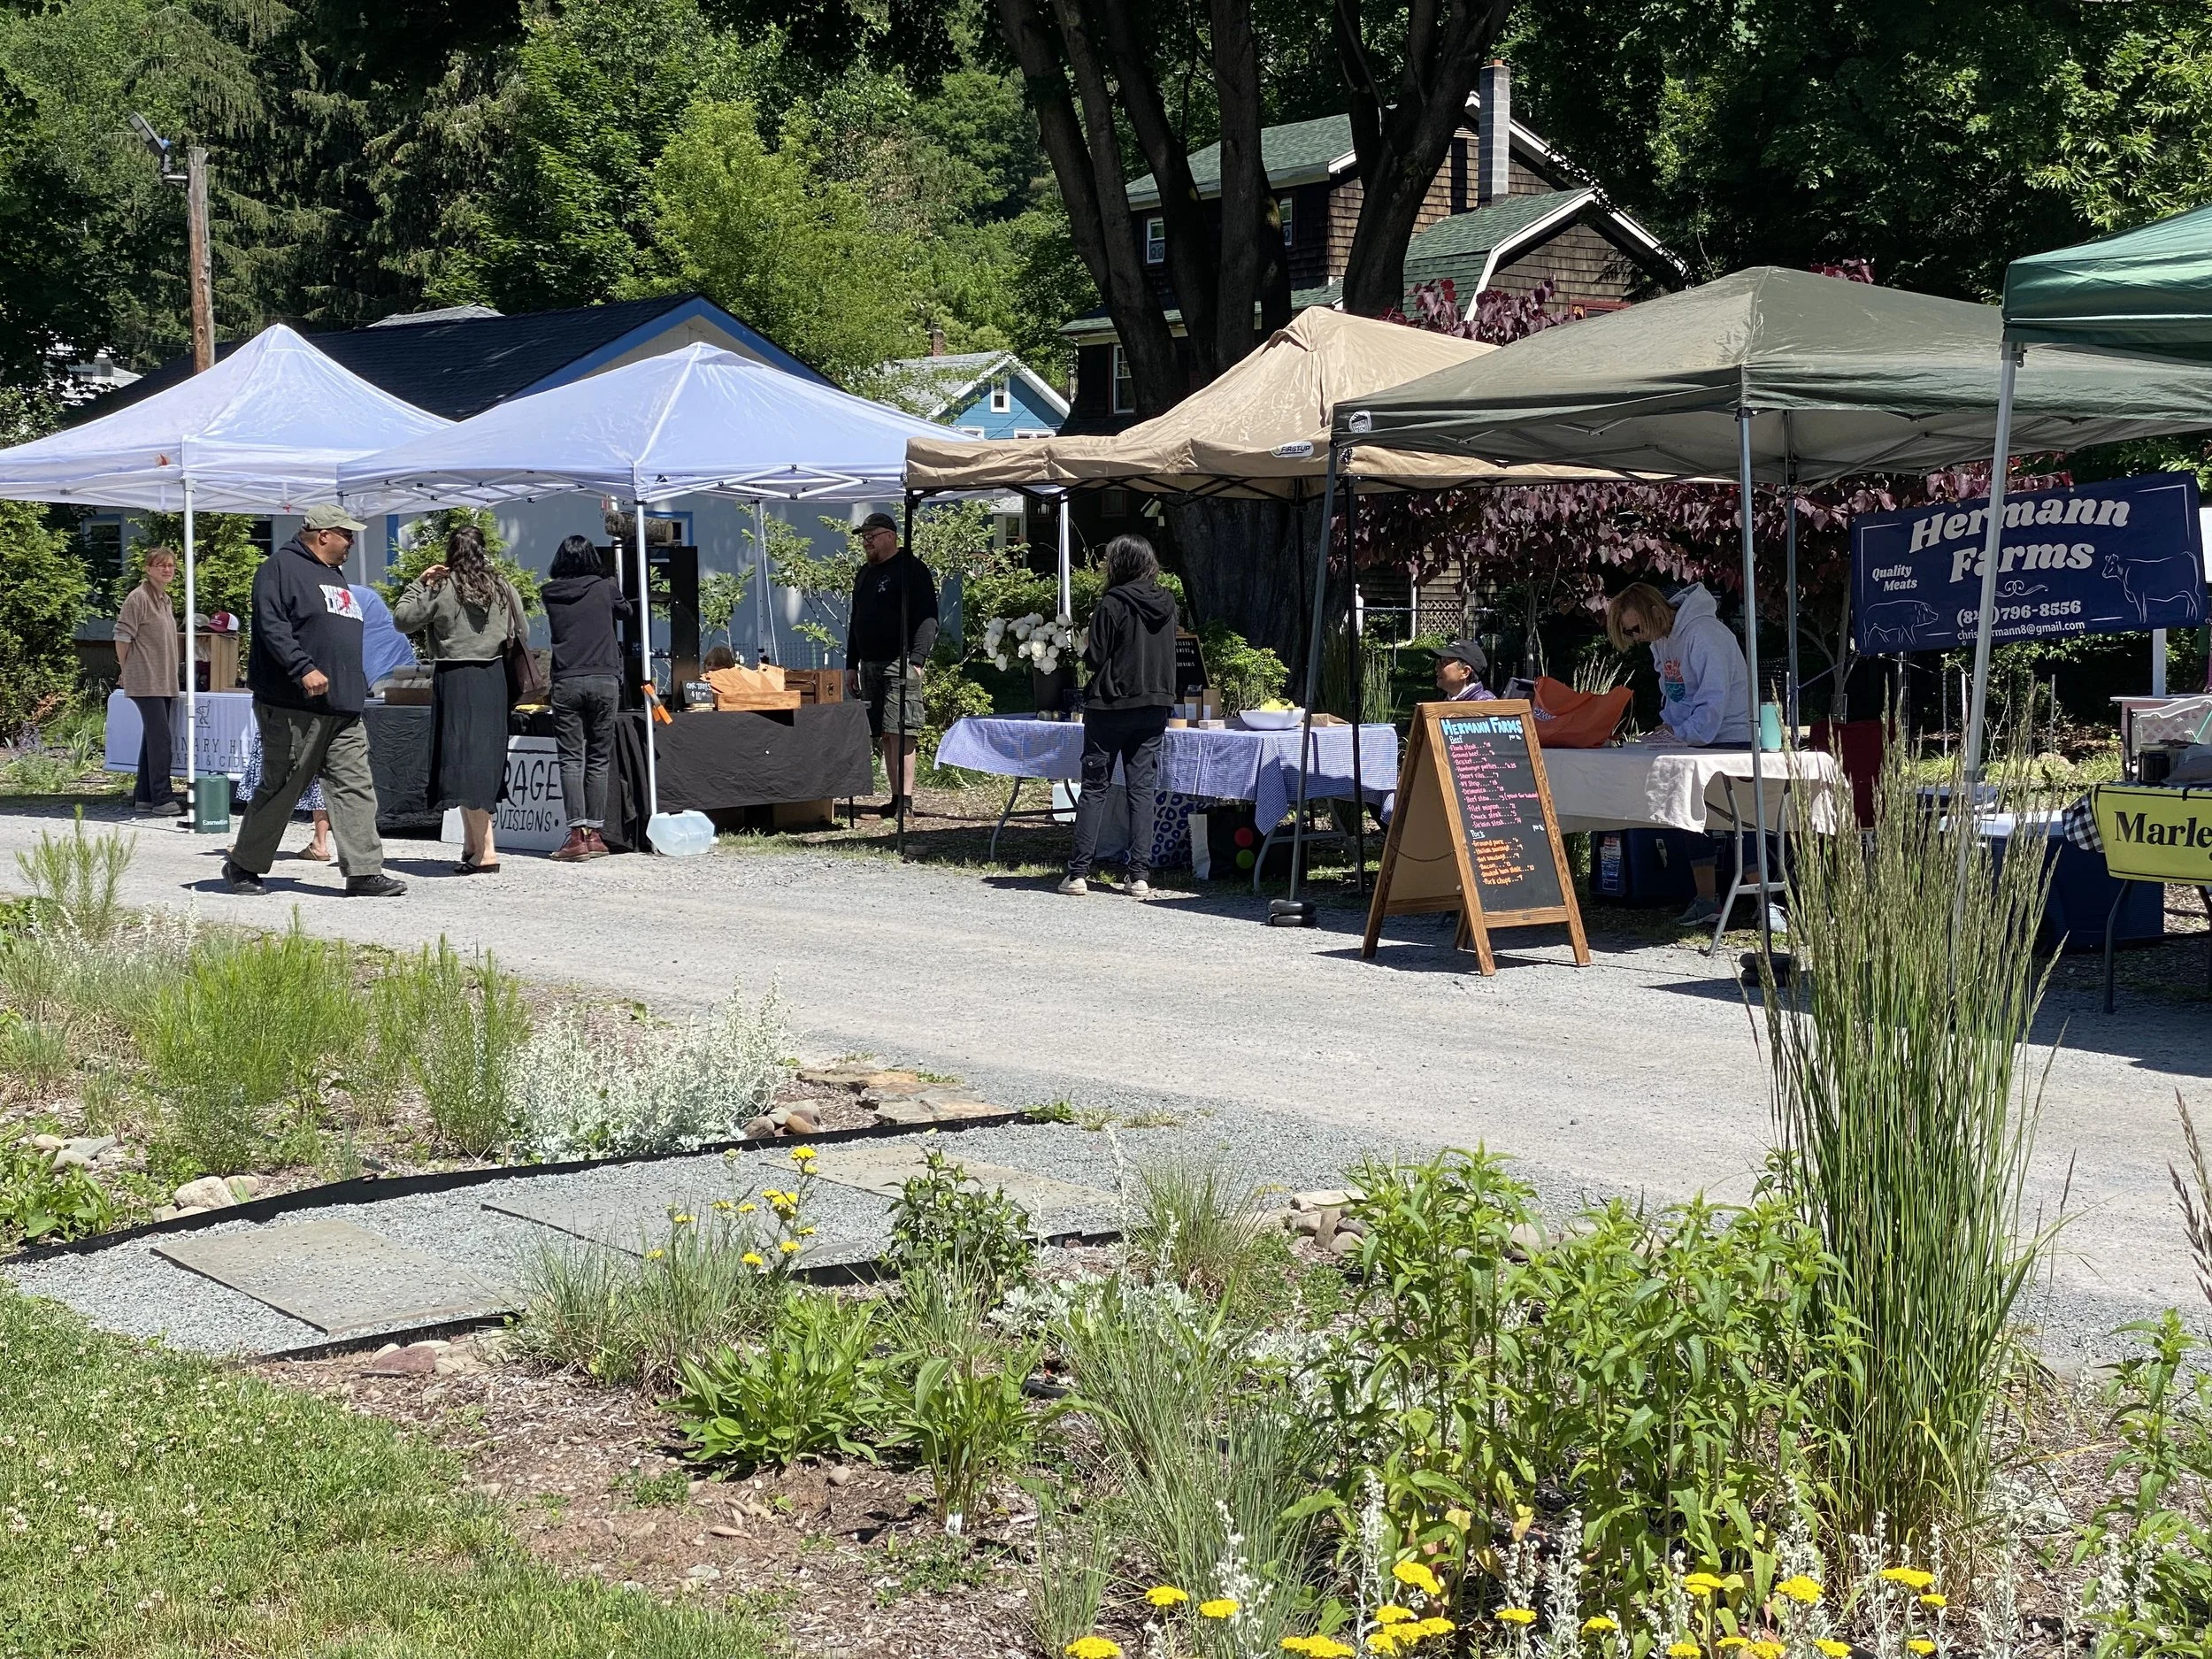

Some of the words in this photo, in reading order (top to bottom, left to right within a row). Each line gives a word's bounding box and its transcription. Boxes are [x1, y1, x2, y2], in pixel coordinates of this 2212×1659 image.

[1909, 498, 2130, 554] Hermann
[1871, 565, 1912, 581] Quality
[1883, 578, 1917, 592] Meats
[1957, 600, 2081, 627] (84)796-8556
[1957, 621, 2085, 641] chrisrmann8@gmail.com
[1440, 718, 1491, 735] HERMANN
[1489, 717, 1523, 733] FARMS
[175, 737, 219, 753] INARY
[229, 740, 254, 755] HIL
[1449, 735, 1463, 744] Beef
[219, 756, 249, 768] CIDE
[503, 759, 565, 807] RAGE
[1470, 829, 1486, 839] Pork
[2114, 811, 2212, 860] Marle
